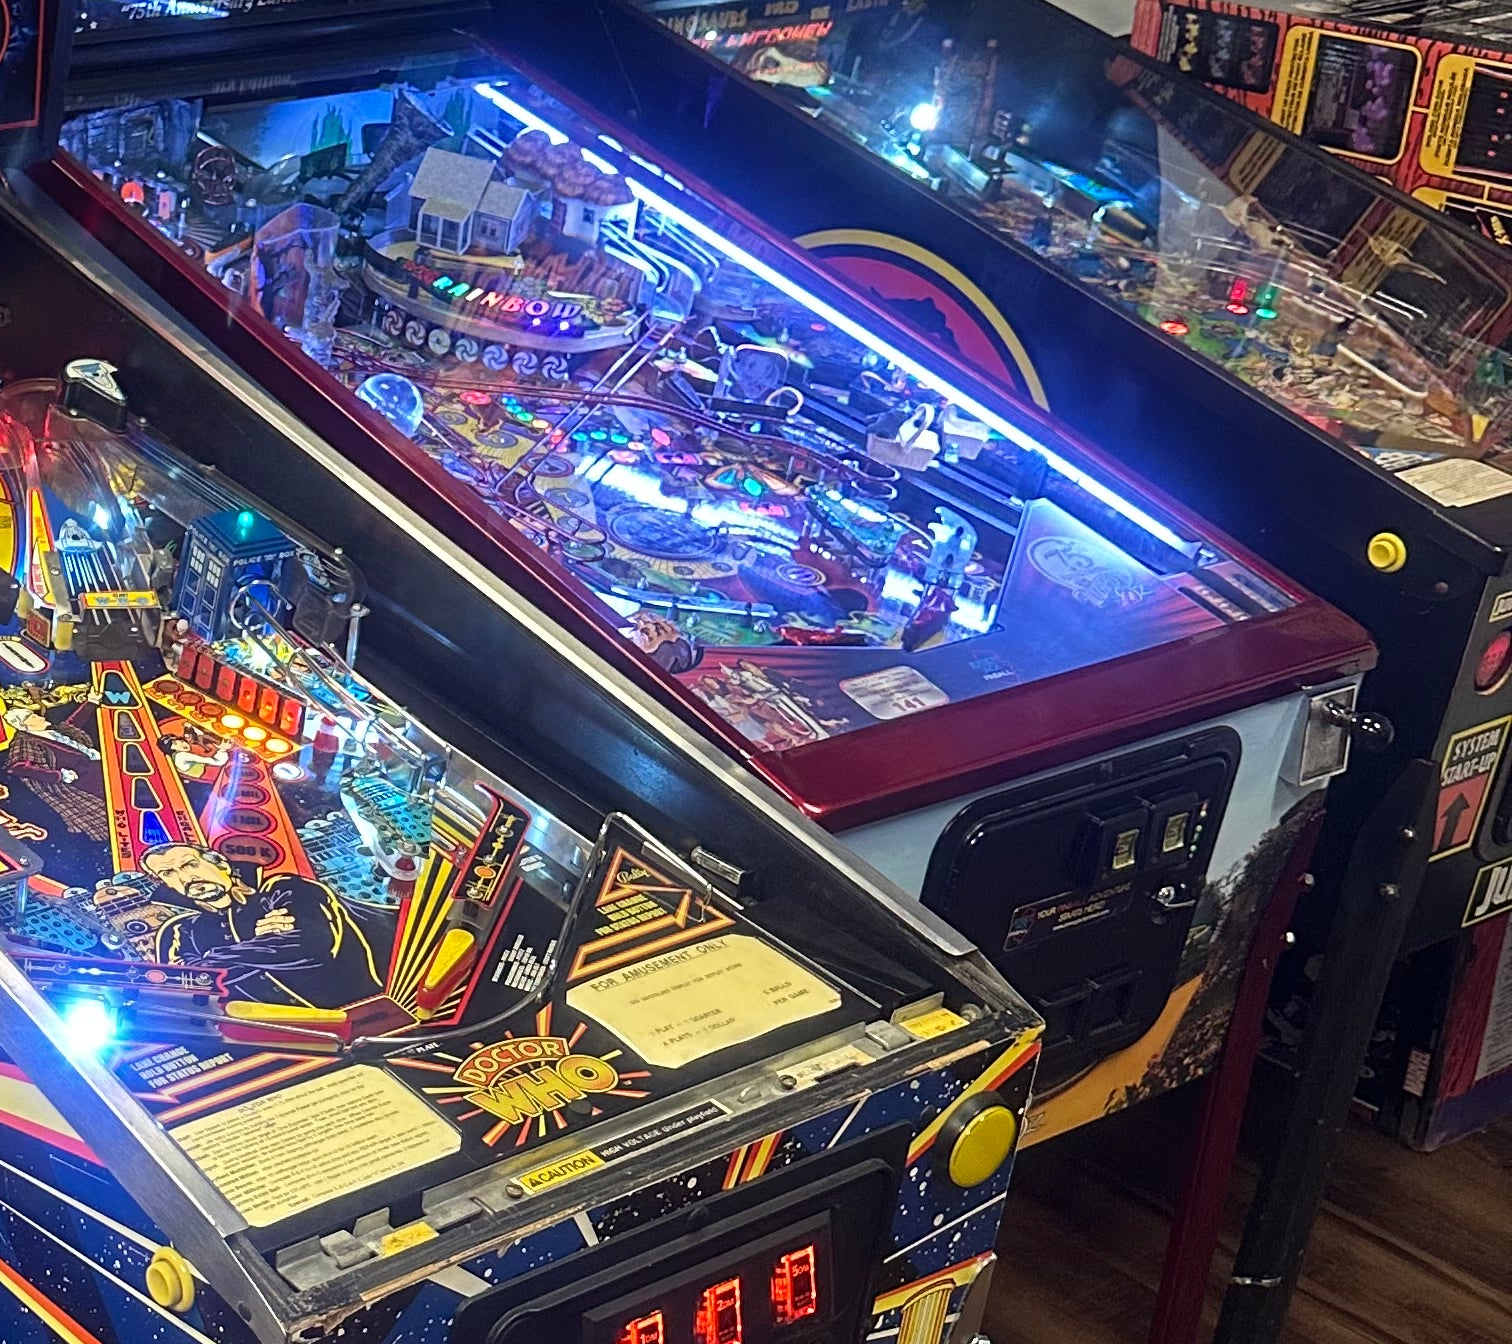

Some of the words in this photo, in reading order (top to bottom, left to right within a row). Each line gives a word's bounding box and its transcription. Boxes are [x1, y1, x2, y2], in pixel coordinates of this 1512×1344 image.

[432, 274, 582, 322] RAINBOW
[232, 554, 263, 567] POLICE
[892, 696, 927, 713] 141
[1452, 727, 1501, 760] SYSTEM
[1442, 751, 1499, 787] START-UP
[590, 977, 618, 994] FOR
[622, 950, 693, 983] AMUSEMENT
[695, 938, 730, 955] ONLY
[461, 1041, 562, 1084] DOCTOR
[462, 1053, 619, 1126] WHO
[537, 1154, 597, 1184] CAUTION
[622, 1127, 661, 1150] VOLTAGE
